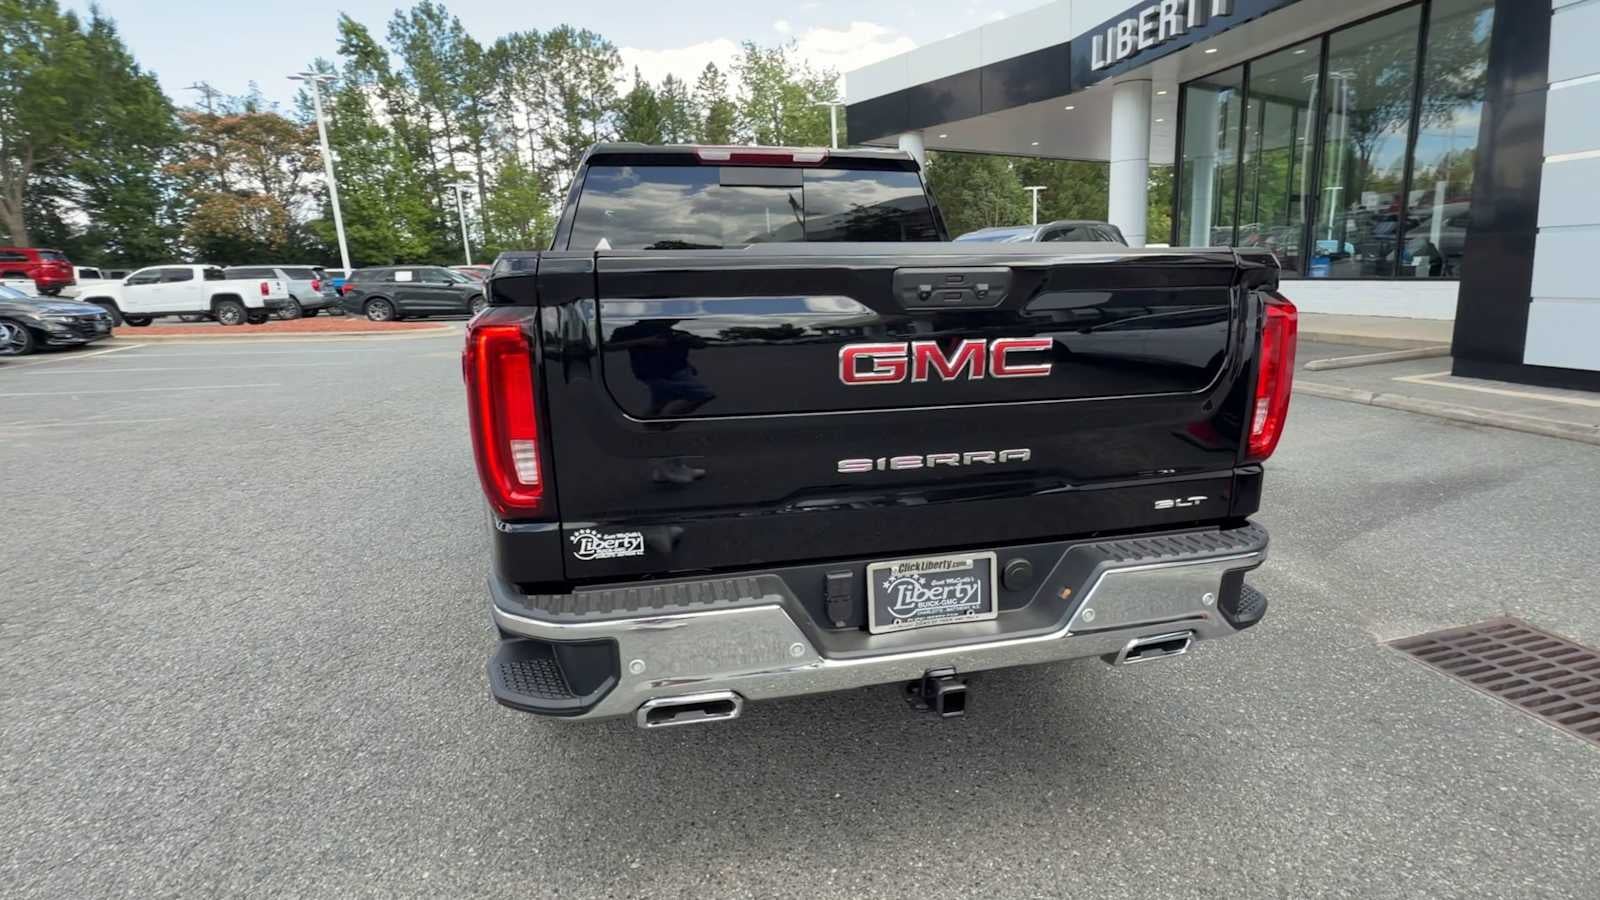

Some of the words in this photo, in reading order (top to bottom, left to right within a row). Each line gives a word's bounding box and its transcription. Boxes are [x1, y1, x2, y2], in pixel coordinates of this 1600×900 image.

[838, 337, 1053, 385] GMC
[837, 448, 1031, 473] SIERRA
[1154, 496, 1208, 510] SLT
[579, 536, 641, 554] Liberty
[893, 582, 978, 610] Liberty
